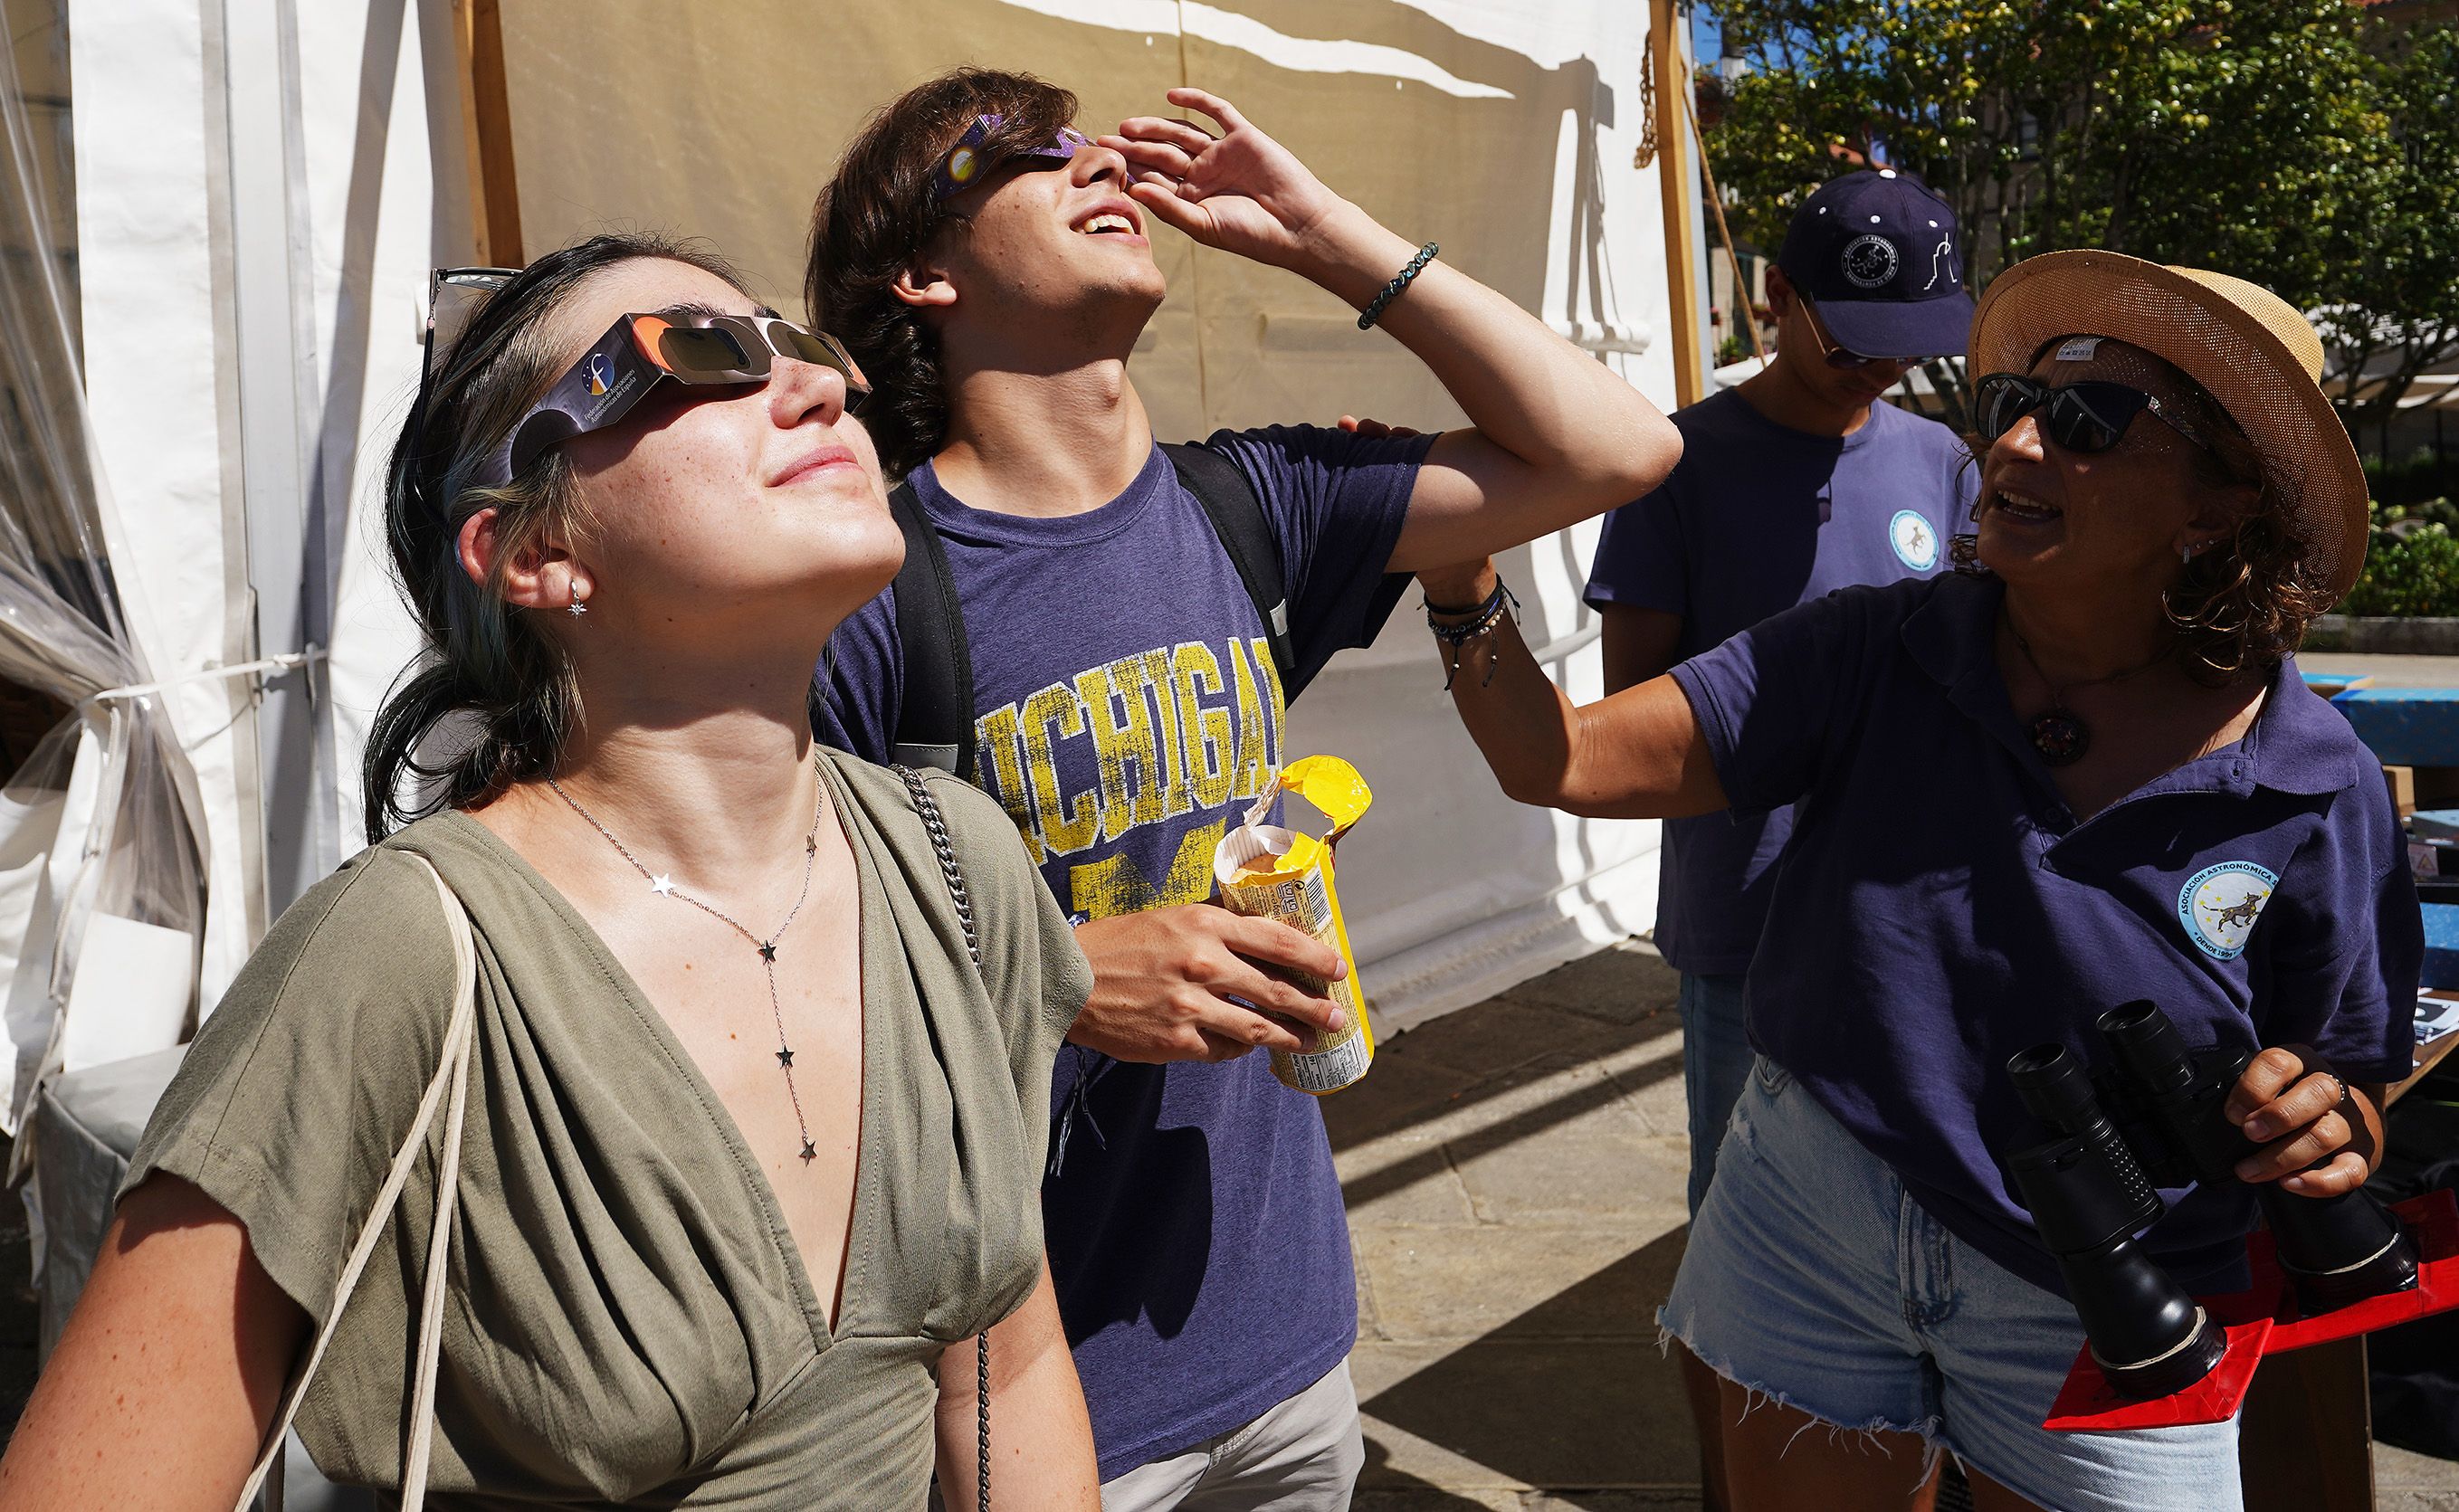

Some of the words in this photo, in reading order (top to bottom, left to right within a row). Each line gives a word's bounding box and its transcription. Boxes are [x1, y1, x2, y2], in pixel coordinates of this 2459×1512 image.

[975, 636, 1285, 866] ICHIGA
[2182, 873, 2206, 915] ASOCIACIÓN
[2207, 863, 2272, 881] ASTRONÓMICA
[2197, 936, 2217, 955] DENDE
[1308, 1055, 1316, 1065] 145
